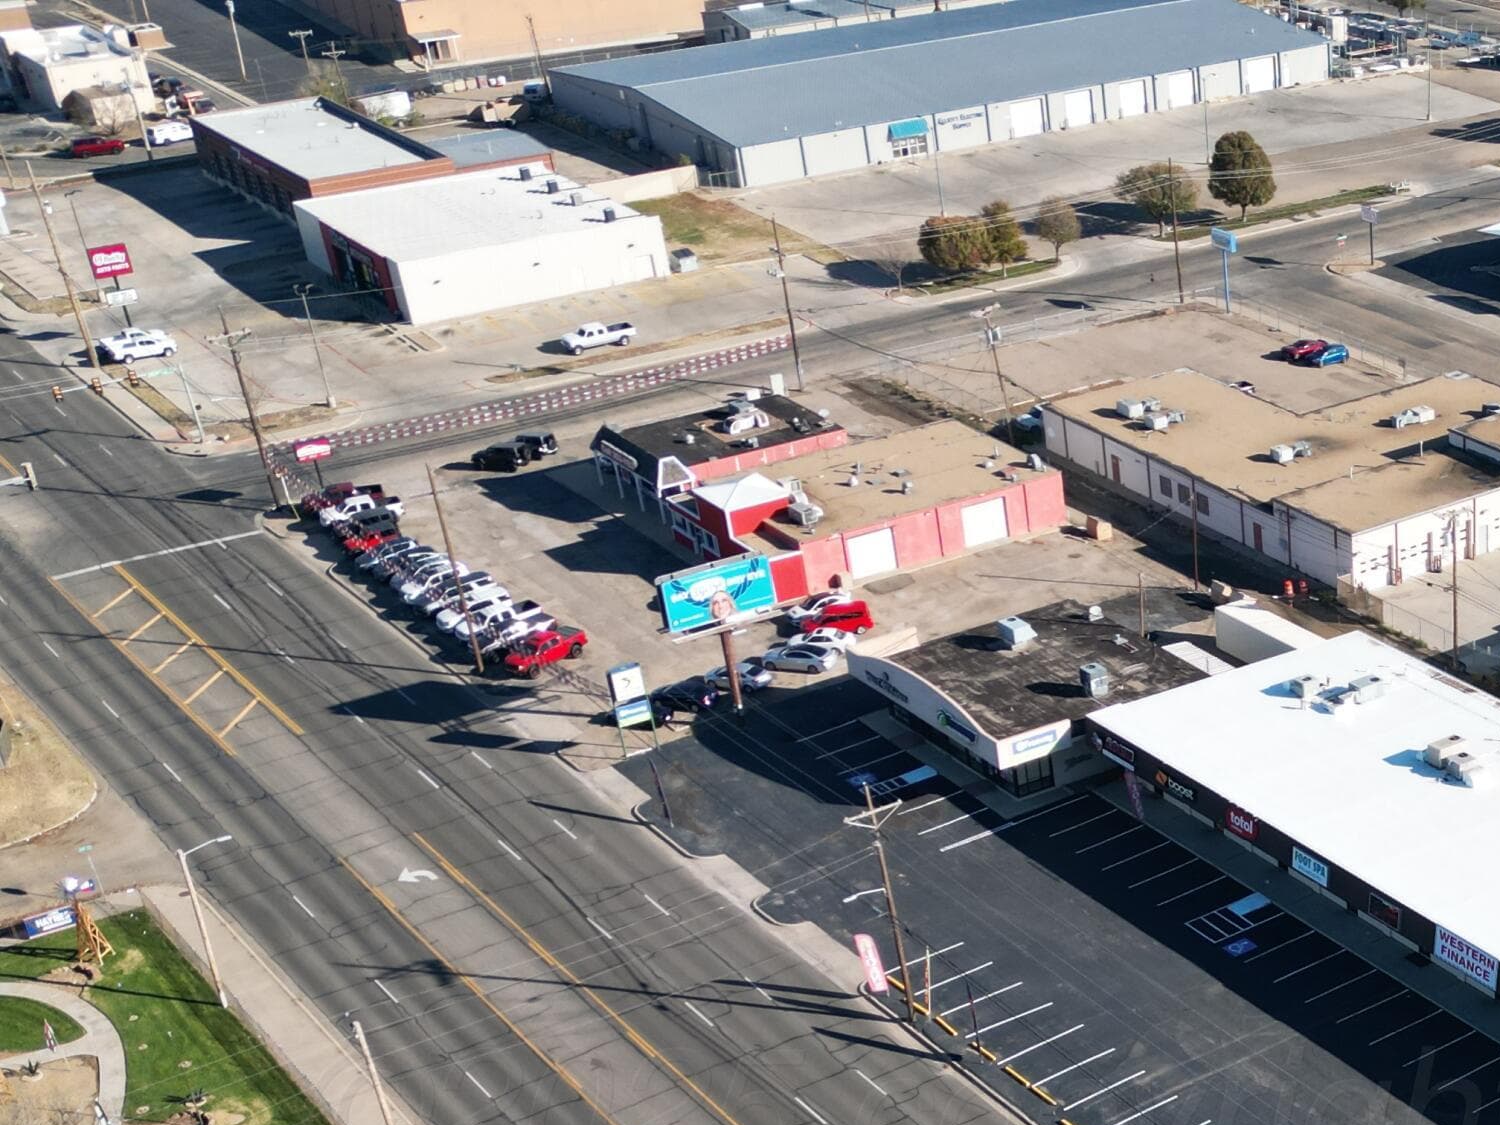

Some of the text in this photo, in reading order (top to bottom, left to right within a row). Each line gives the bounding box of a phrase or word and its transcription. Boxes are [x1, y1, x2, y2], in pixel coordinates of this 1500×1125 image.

[1294, 850, 1312, 871] FOOT
[1313, 861, 1327, 879] SPA
[1439, 929, 1495, 971] WESTERN
[1440, 944, 1491, 983] FINANCE
